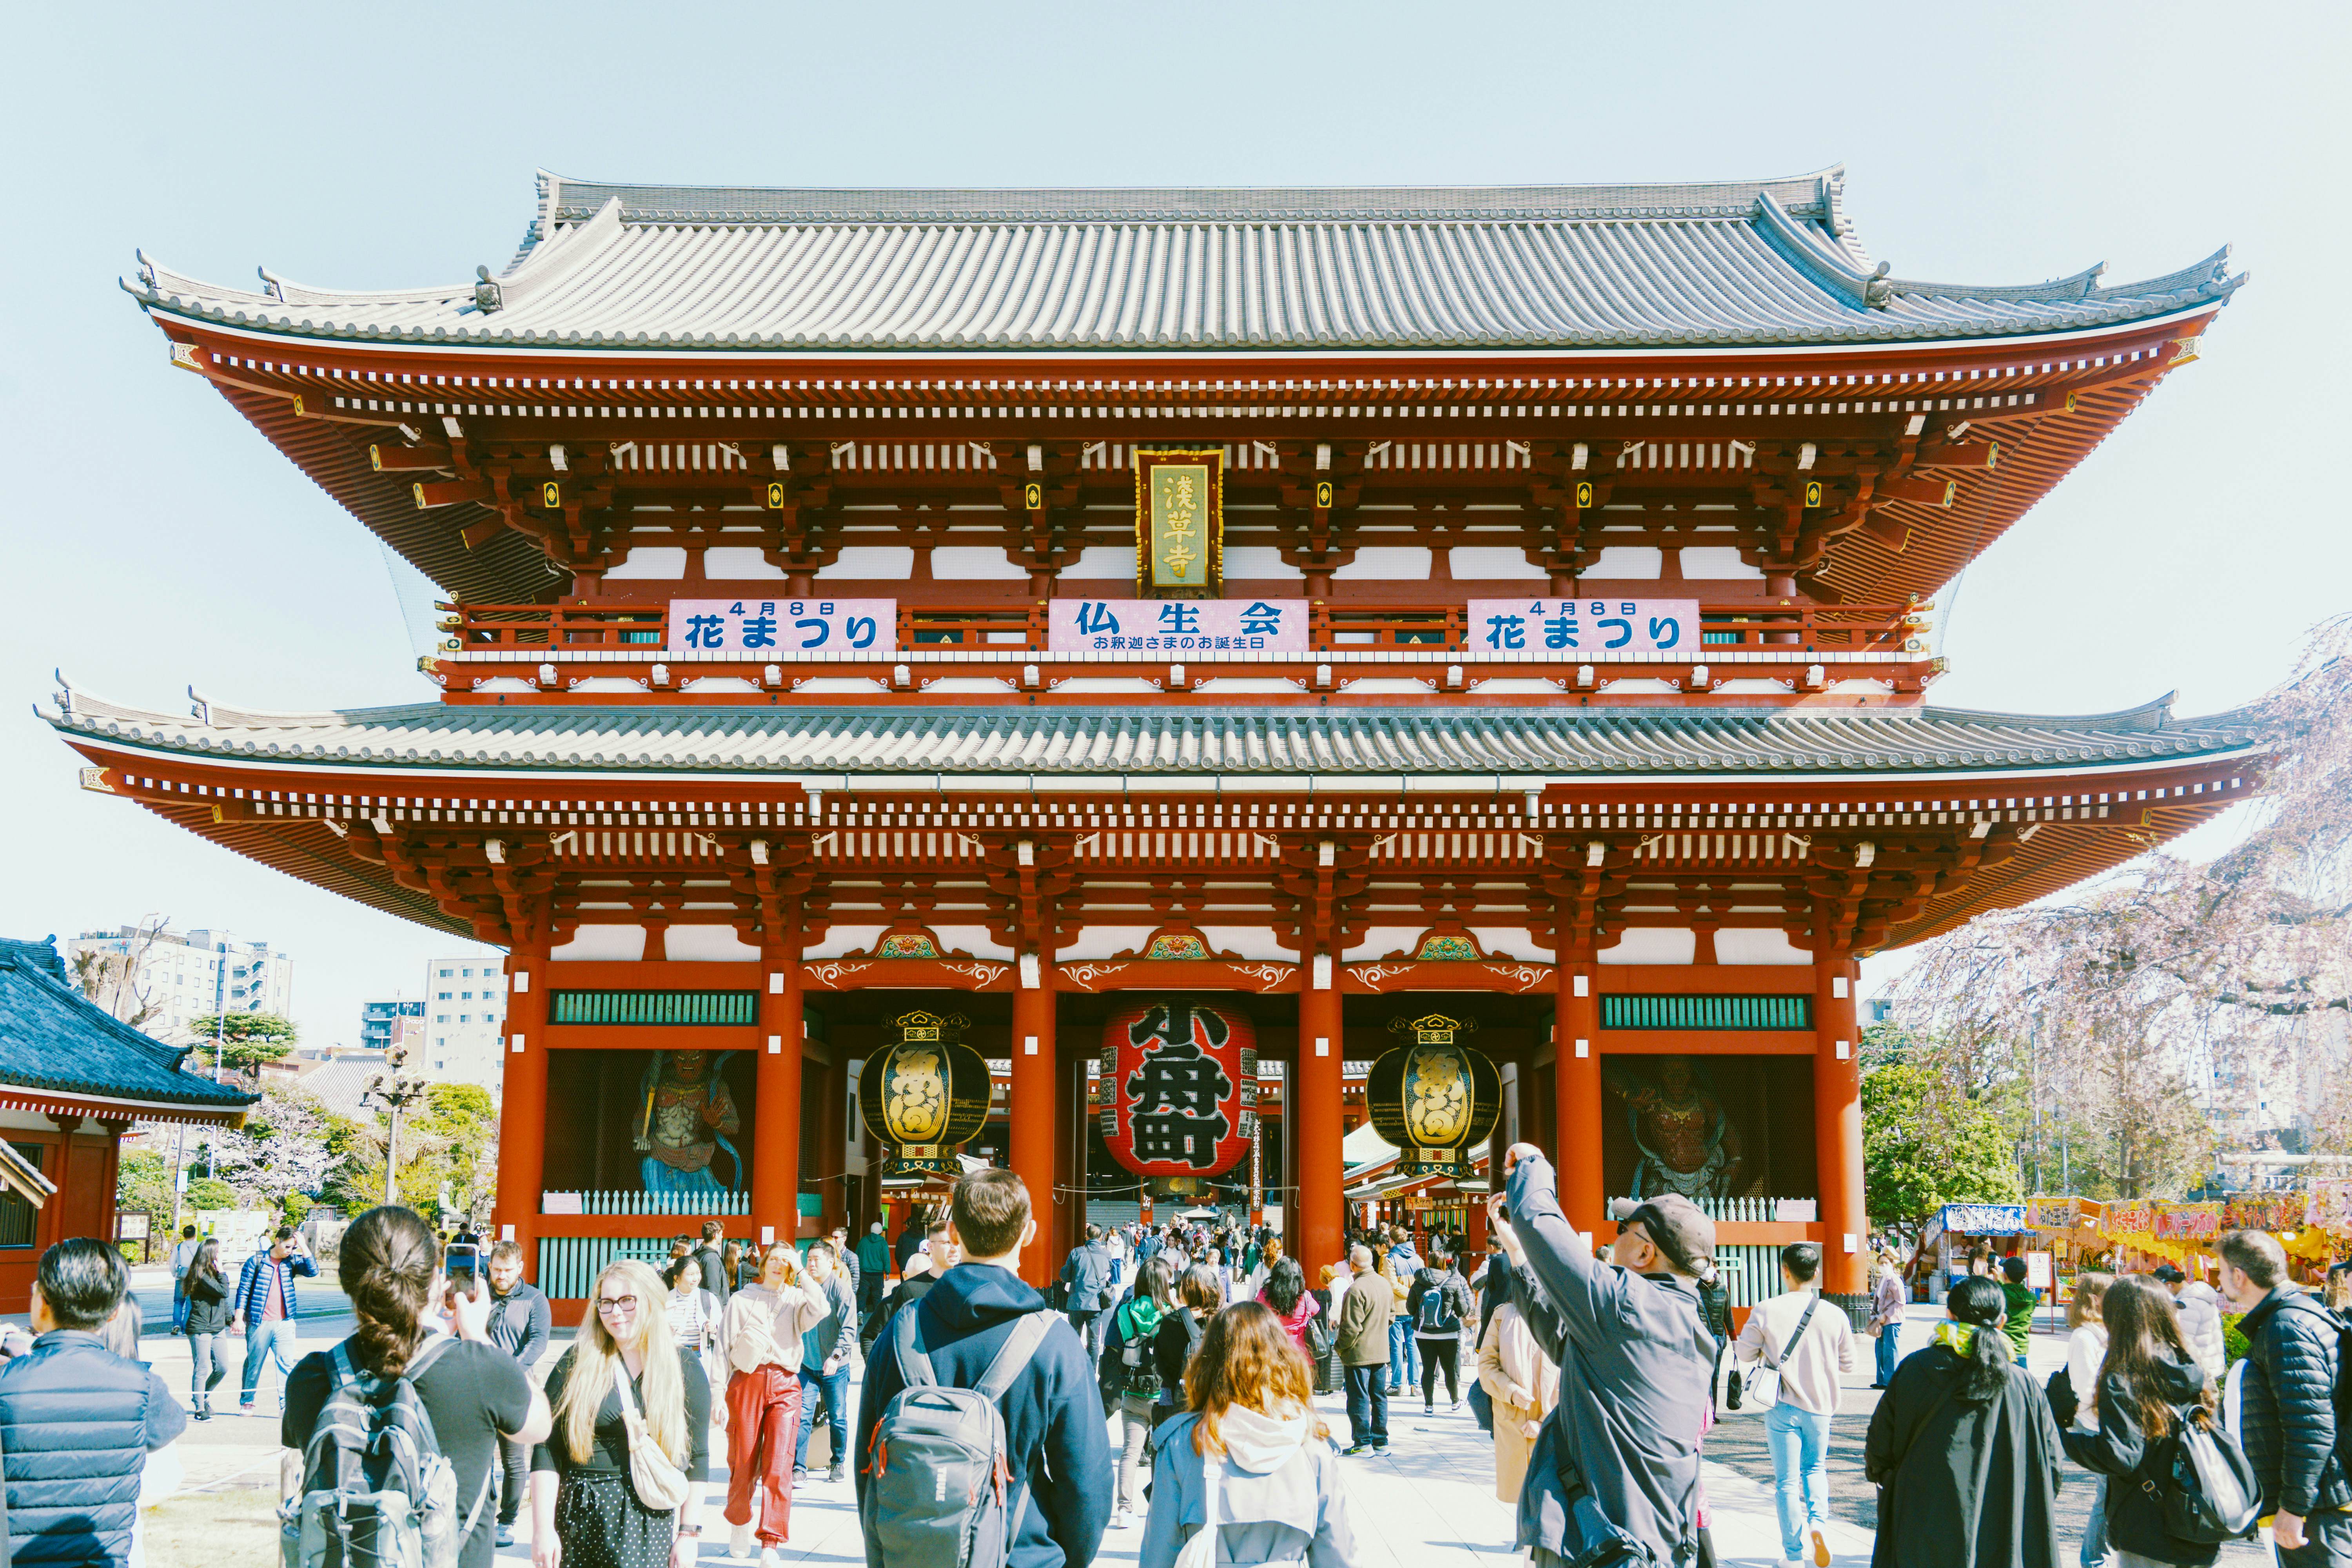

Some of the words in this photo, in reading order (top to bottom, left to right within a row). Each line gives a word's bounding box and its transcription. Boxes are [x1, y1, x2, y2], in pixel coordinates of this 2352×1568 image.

[729, 602, 834, 615] 4月8日
[1074, 602, 1283, 635] 仏生会
[1529, 601, 1636, 615] 4月8日
[684, 614, 877, 649] 花まつり
[1093, 636, 1265, 649] お釈迦さまのお誕生日
[1486, 614, 1680, 649] 花まつり
[2112, 1209, 2149, 1233] やきそば
[935, 1466, 947, 1501] THULE
